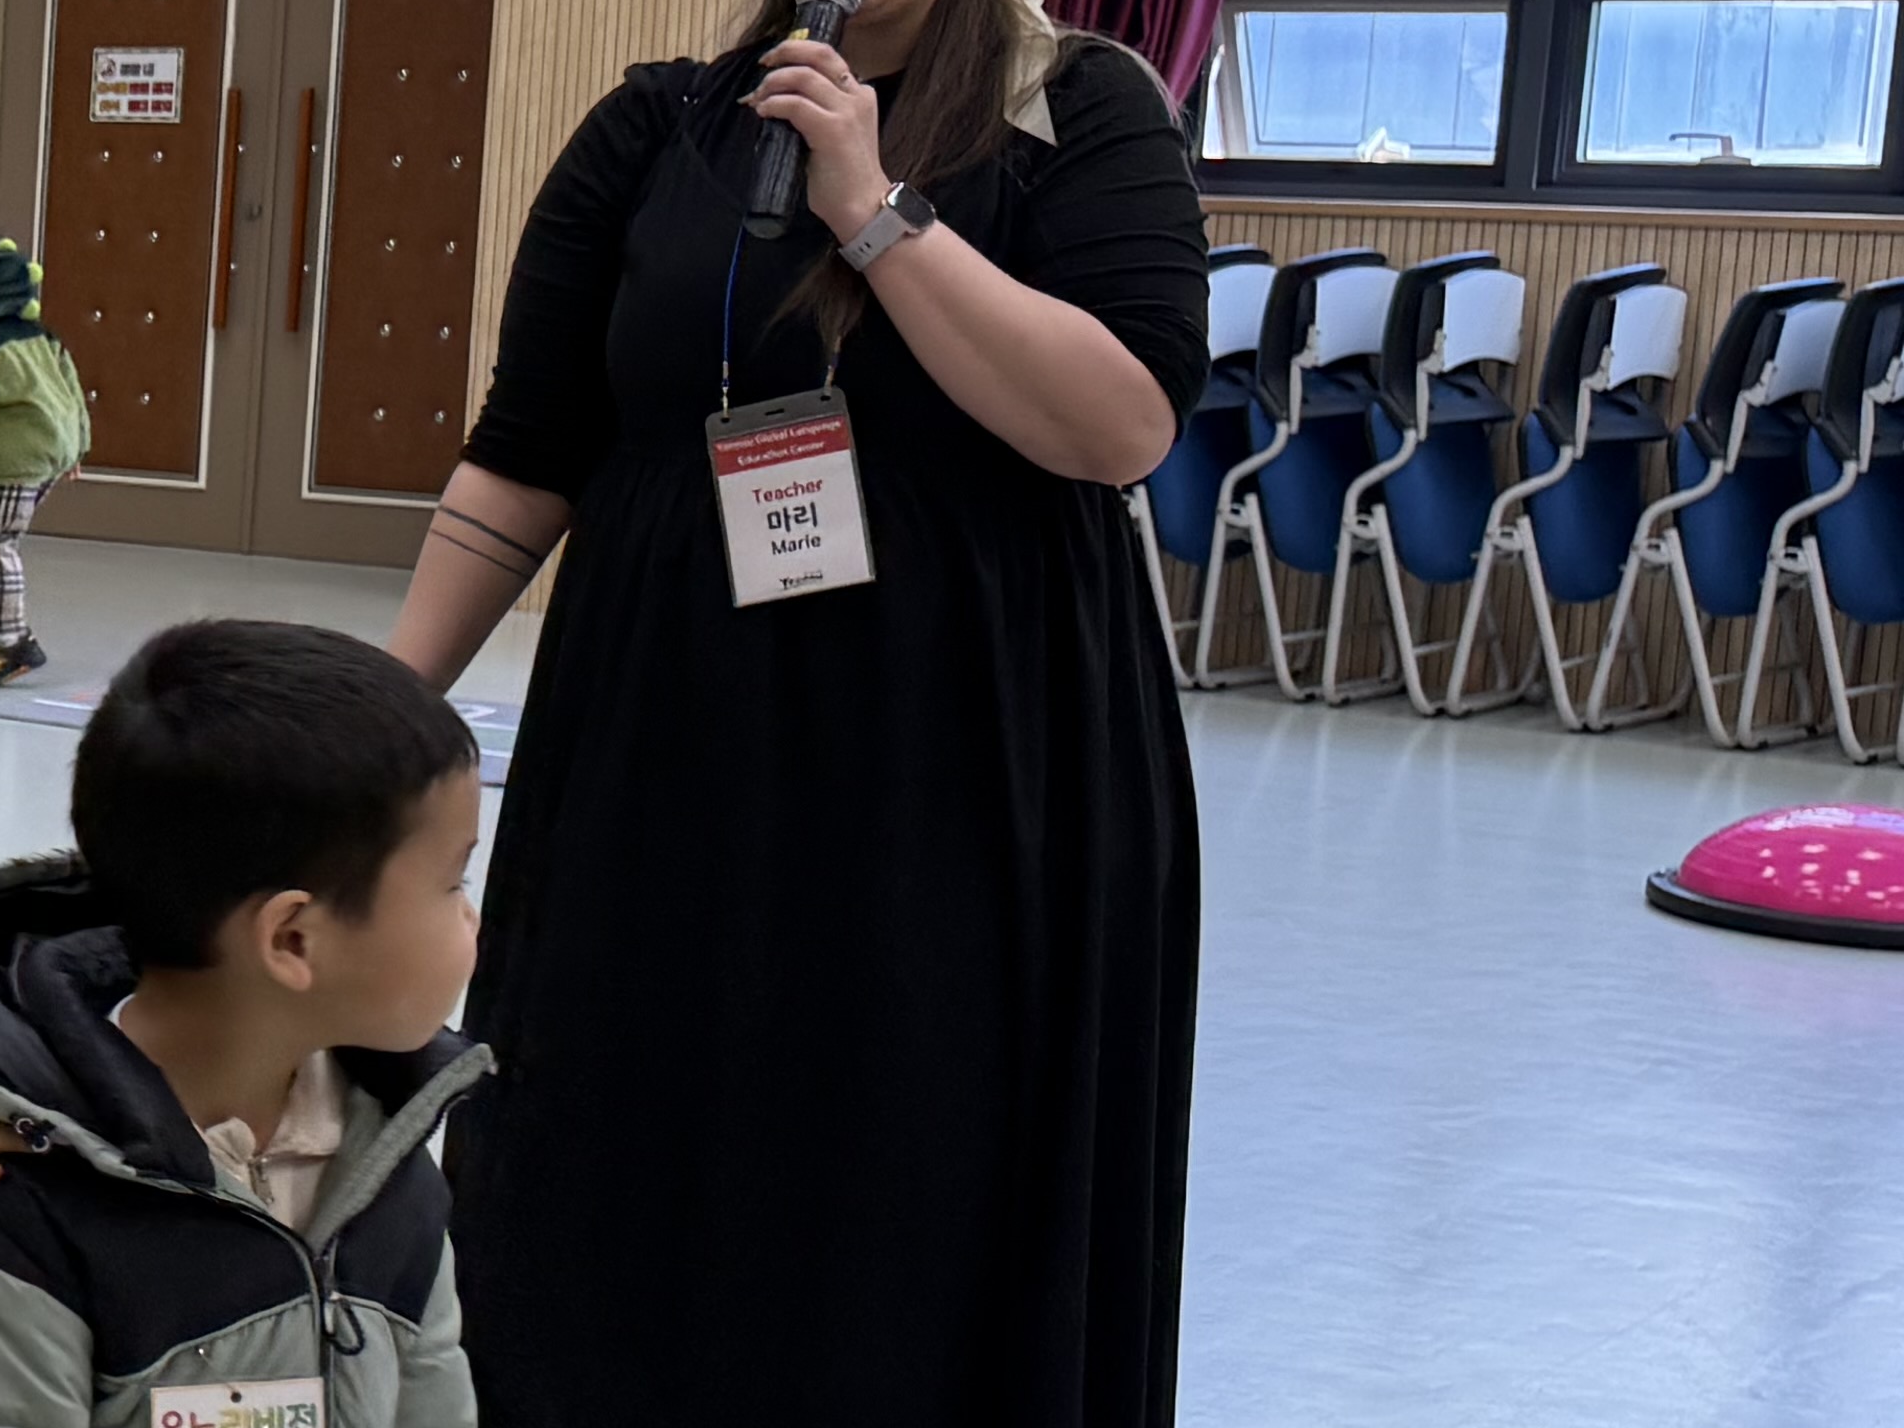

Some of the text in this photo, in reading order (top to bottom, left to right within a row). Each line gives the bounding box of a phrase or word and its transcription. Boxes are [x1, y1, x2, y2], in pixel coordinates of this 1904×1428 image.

[752, 479, 823, 504] Teacher
[767, 501, 819, 532] 마리
[771, 533, 822, 556] Marie
